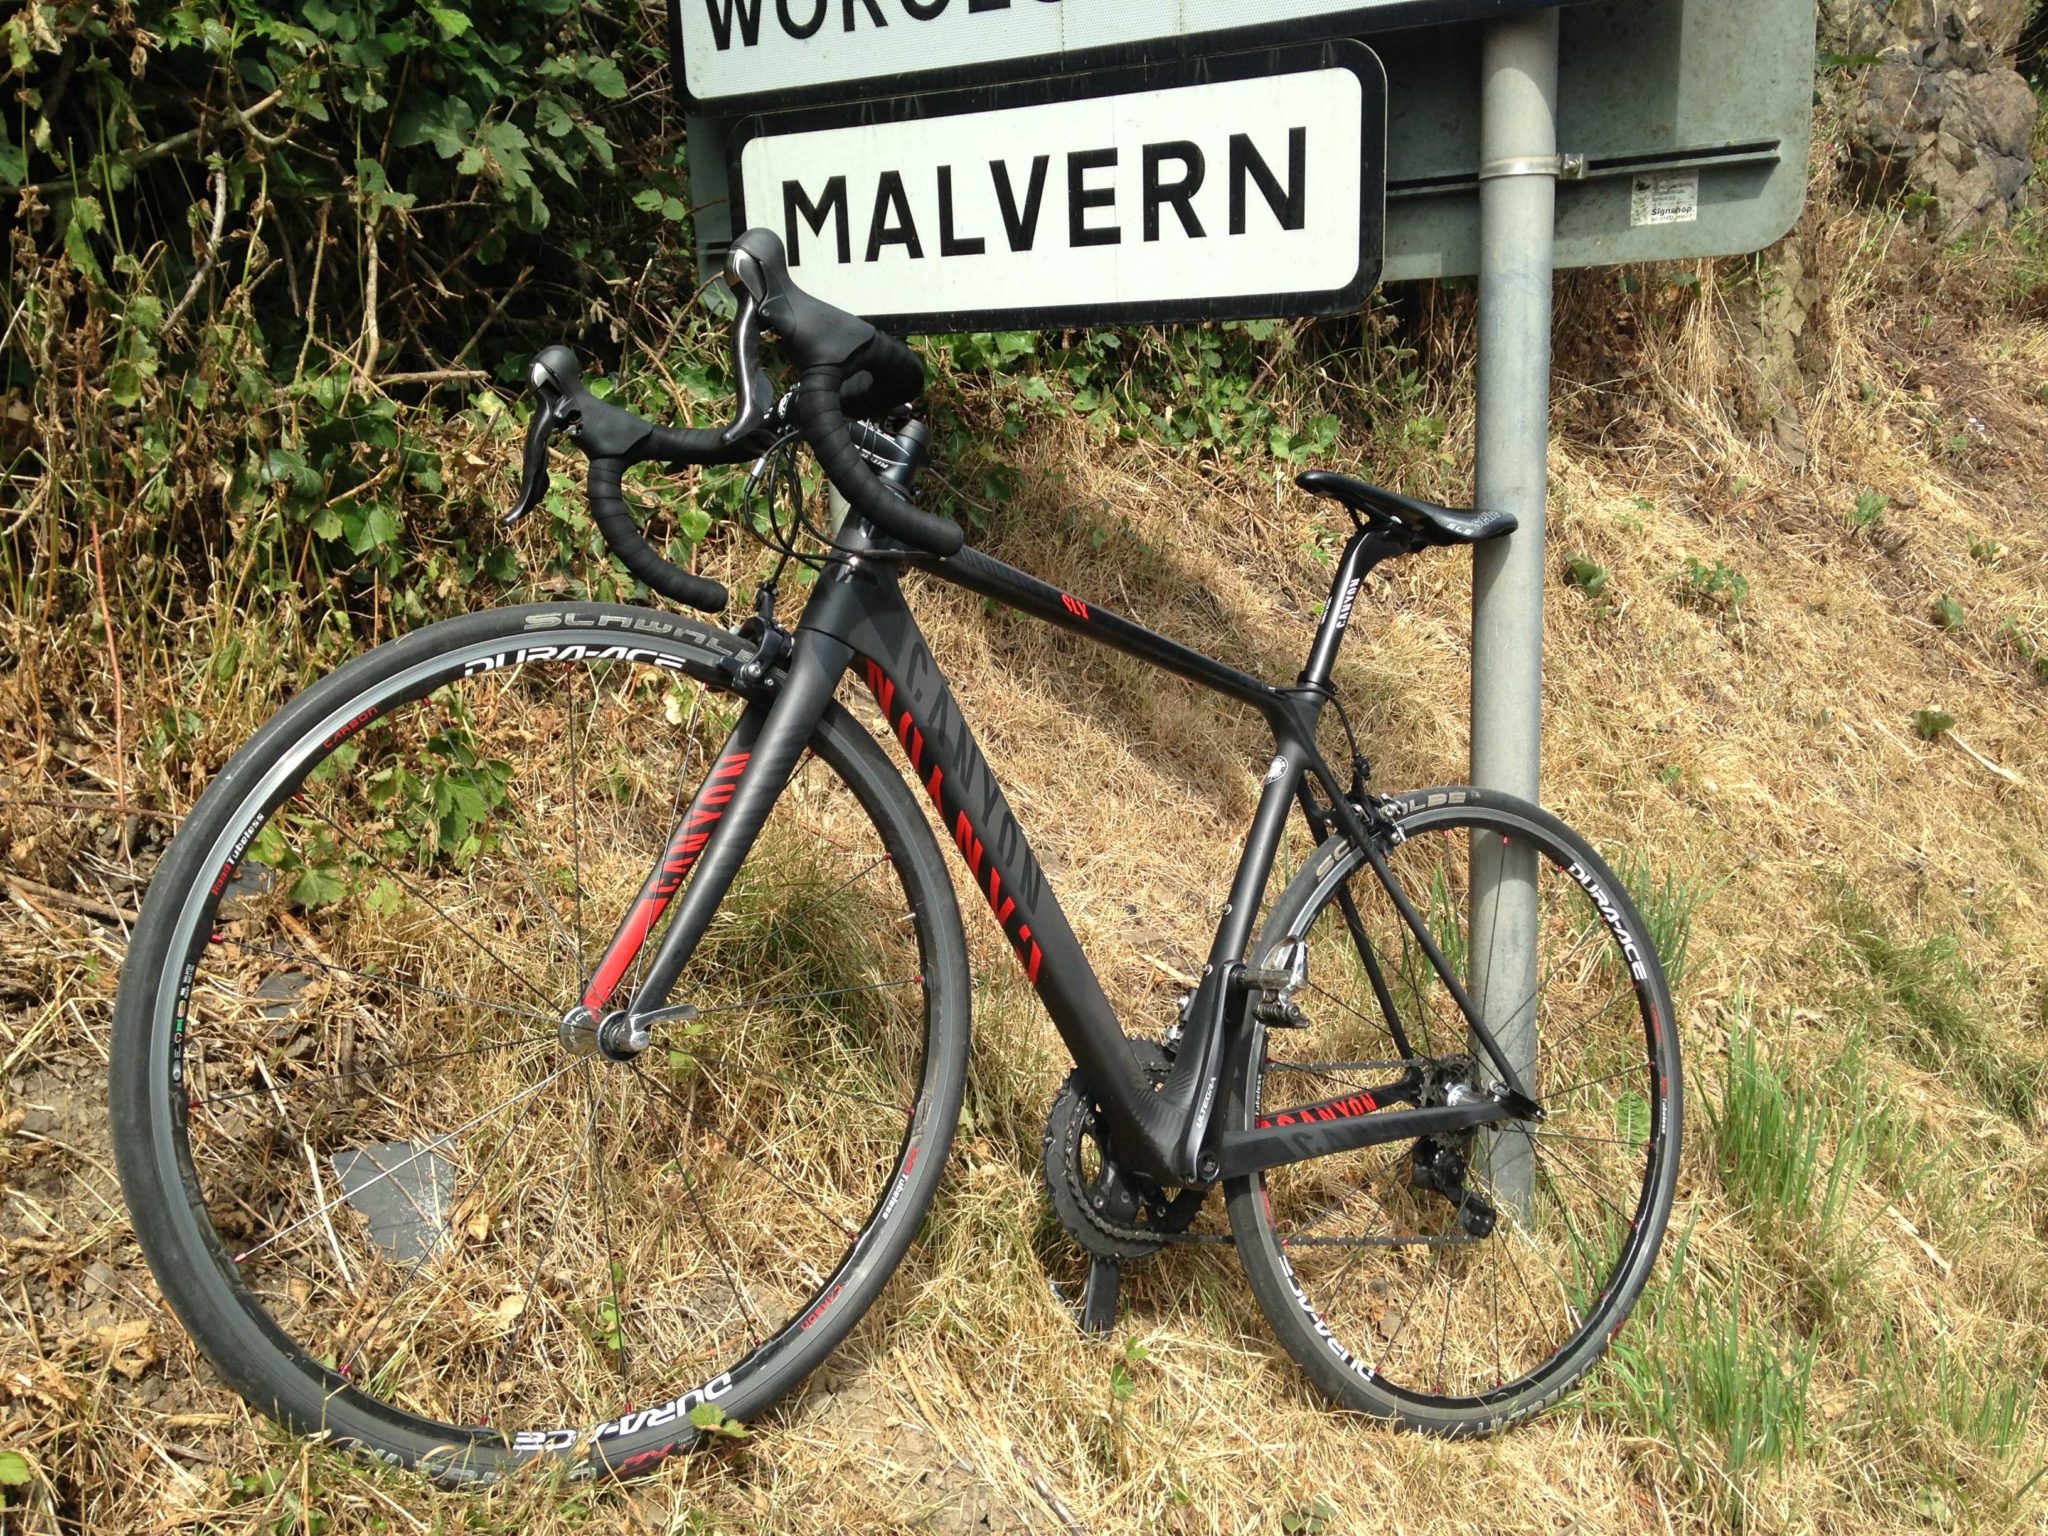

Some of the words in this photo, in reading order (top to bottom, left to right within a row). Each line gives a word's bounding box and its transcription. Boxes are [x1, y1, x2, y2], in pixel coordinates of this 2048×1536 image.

[782, 127, 1307, 267] MALVERN
[464, 645, 687, 678] DURA-ACE
[523, 612, 762, 664] SCHWALB
[1336, 578, 1360, 629] CANYON
[649, 752, 751, 893] CANYON
[906, 641, 1042, 915] CANYON
[228, 812, 265, 866] Tubeless
[1567, 861, 1648, 981] DURA-ACE
[1279, 1254, 1375, 1382] DURA-ACE
